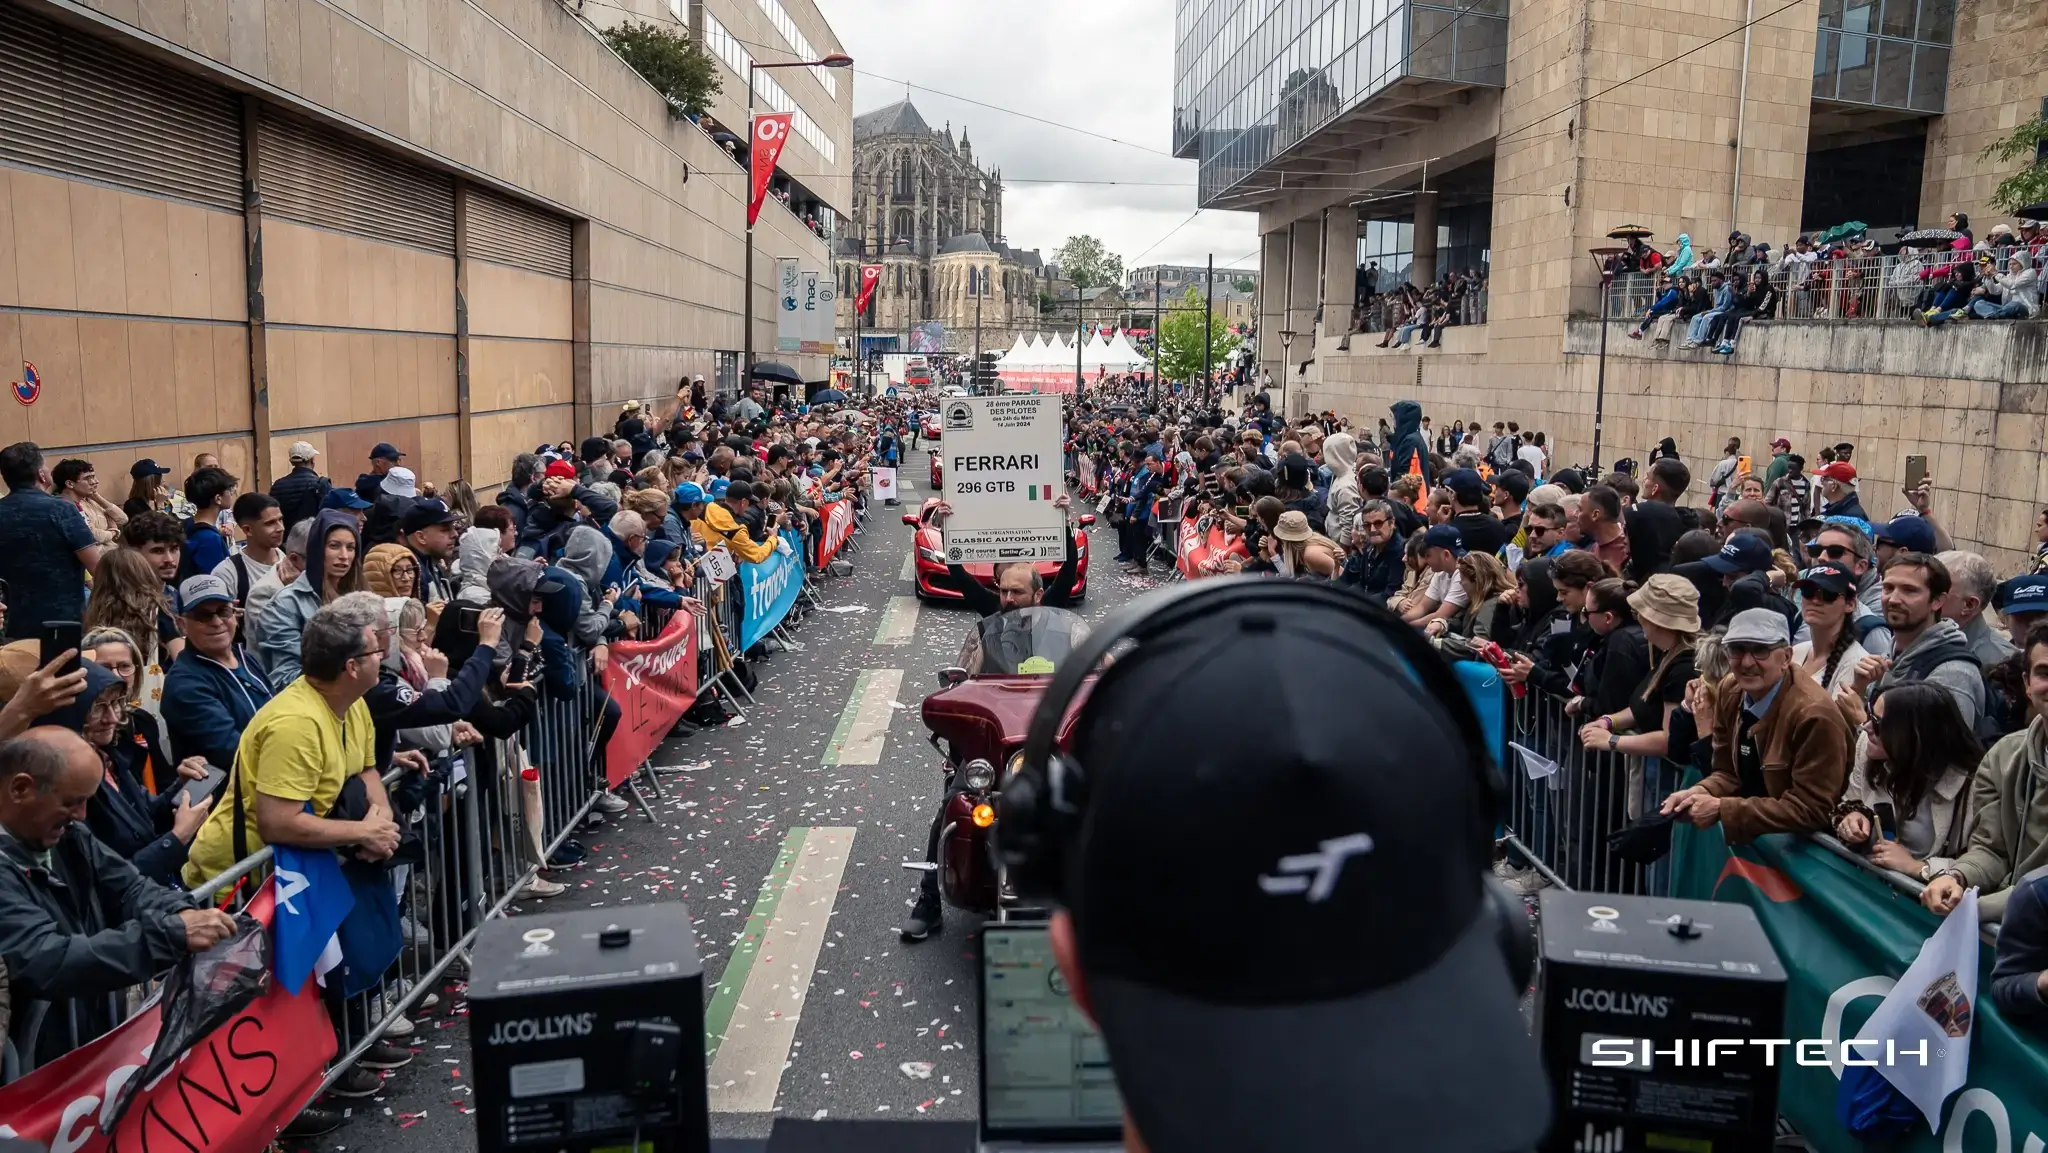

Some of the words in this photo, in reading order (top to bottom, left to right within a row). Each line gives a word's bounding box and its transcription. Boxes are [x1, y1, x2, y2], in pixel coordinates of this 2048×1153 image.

[805, 278, 815, 311] fnac
[1006, 407, 1037, 415] PILOTES
[1011, 399, 1041, 407] PARADE
[954, 453, 1039, 472] FERRARI
[957, 482, 982, 494] 296
[985, 481, 1015, 493] GTB
[995, 535, 1058, 543] AUTOMOTIVE
[708, 555, 723, 577] 155
[2013, 585, 2046, 594] WEC
[649, 634, 690, 677] course
[631, 685, 650, 733] LE
[1564, 987, 1669, 1018] J.COLLYNS
[488, 1013, 593, 1046] J.COLLYNS
